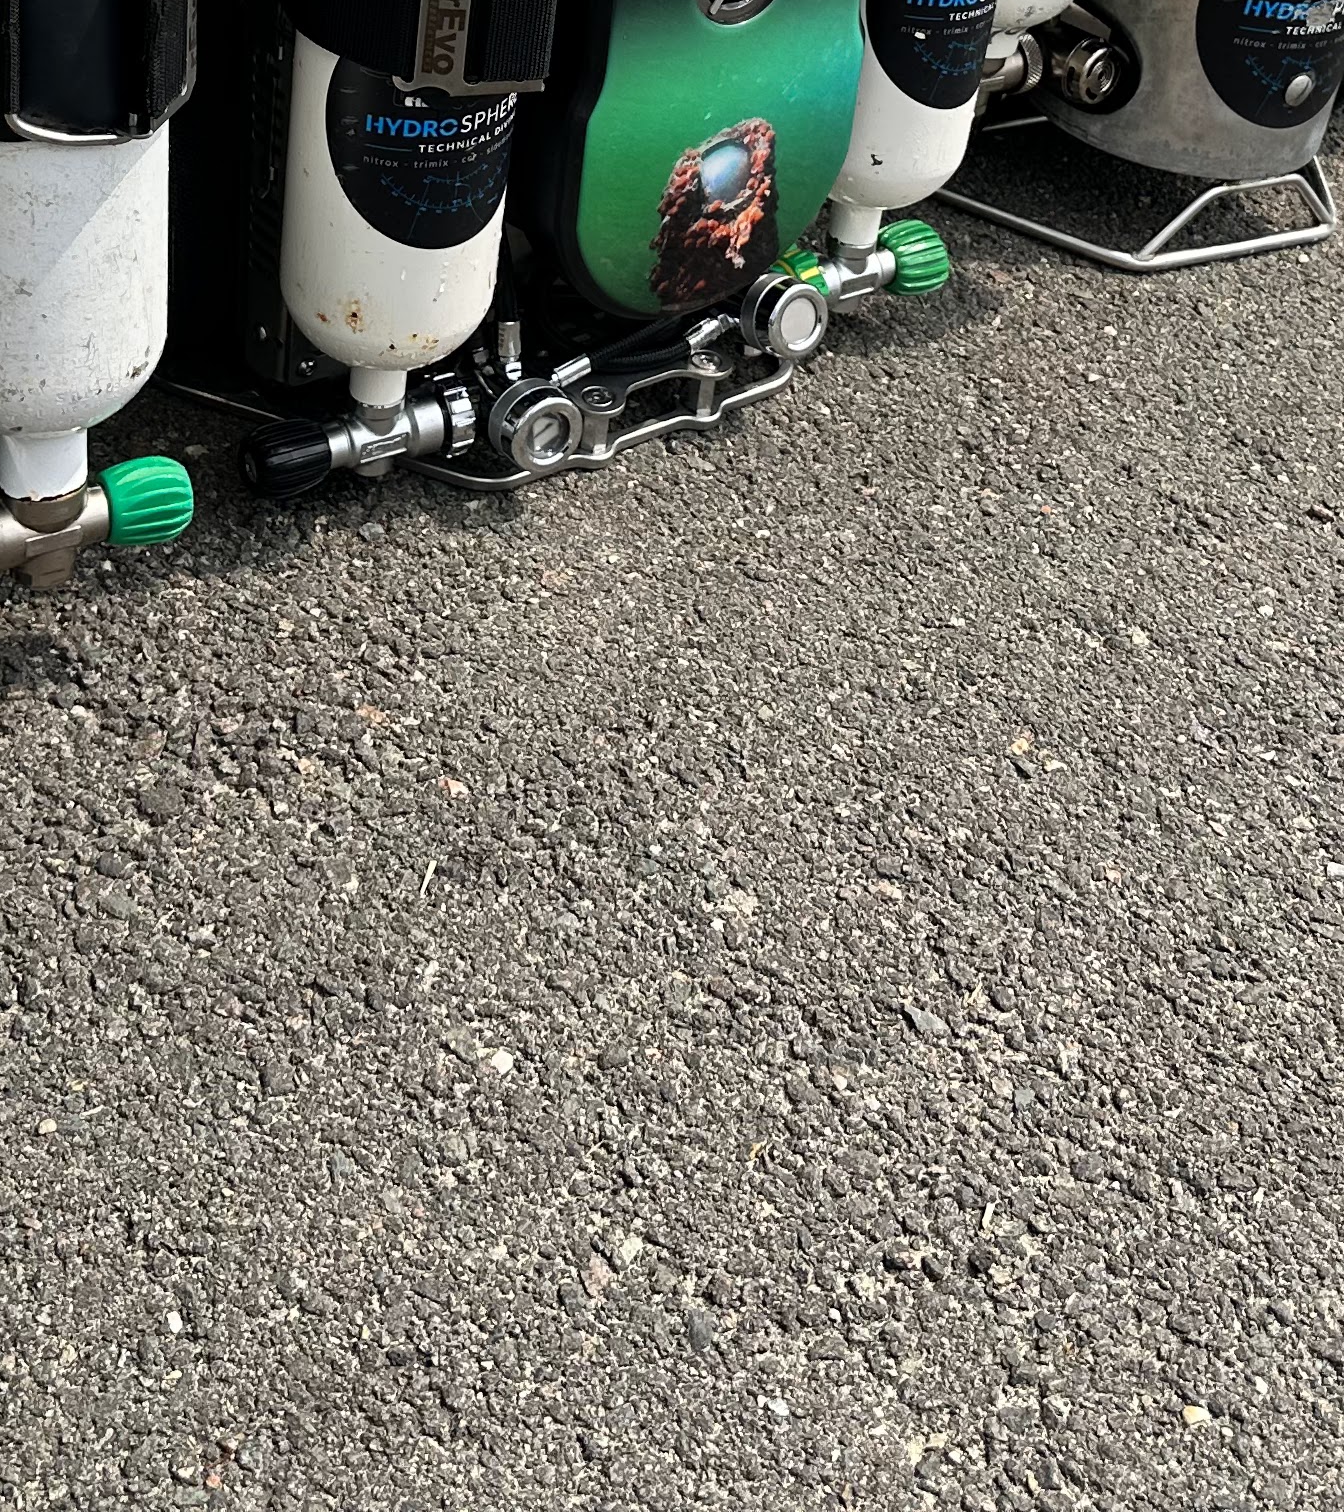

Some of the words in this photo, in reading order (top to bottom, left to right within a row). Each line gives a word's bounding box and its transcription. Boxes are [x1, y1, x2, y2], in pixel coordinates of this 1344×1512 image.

[418, 131, 492, 154] TECHNICAL
[363, 156, 399, 168] nitrox
[414, 159, 449, 169] trimix
